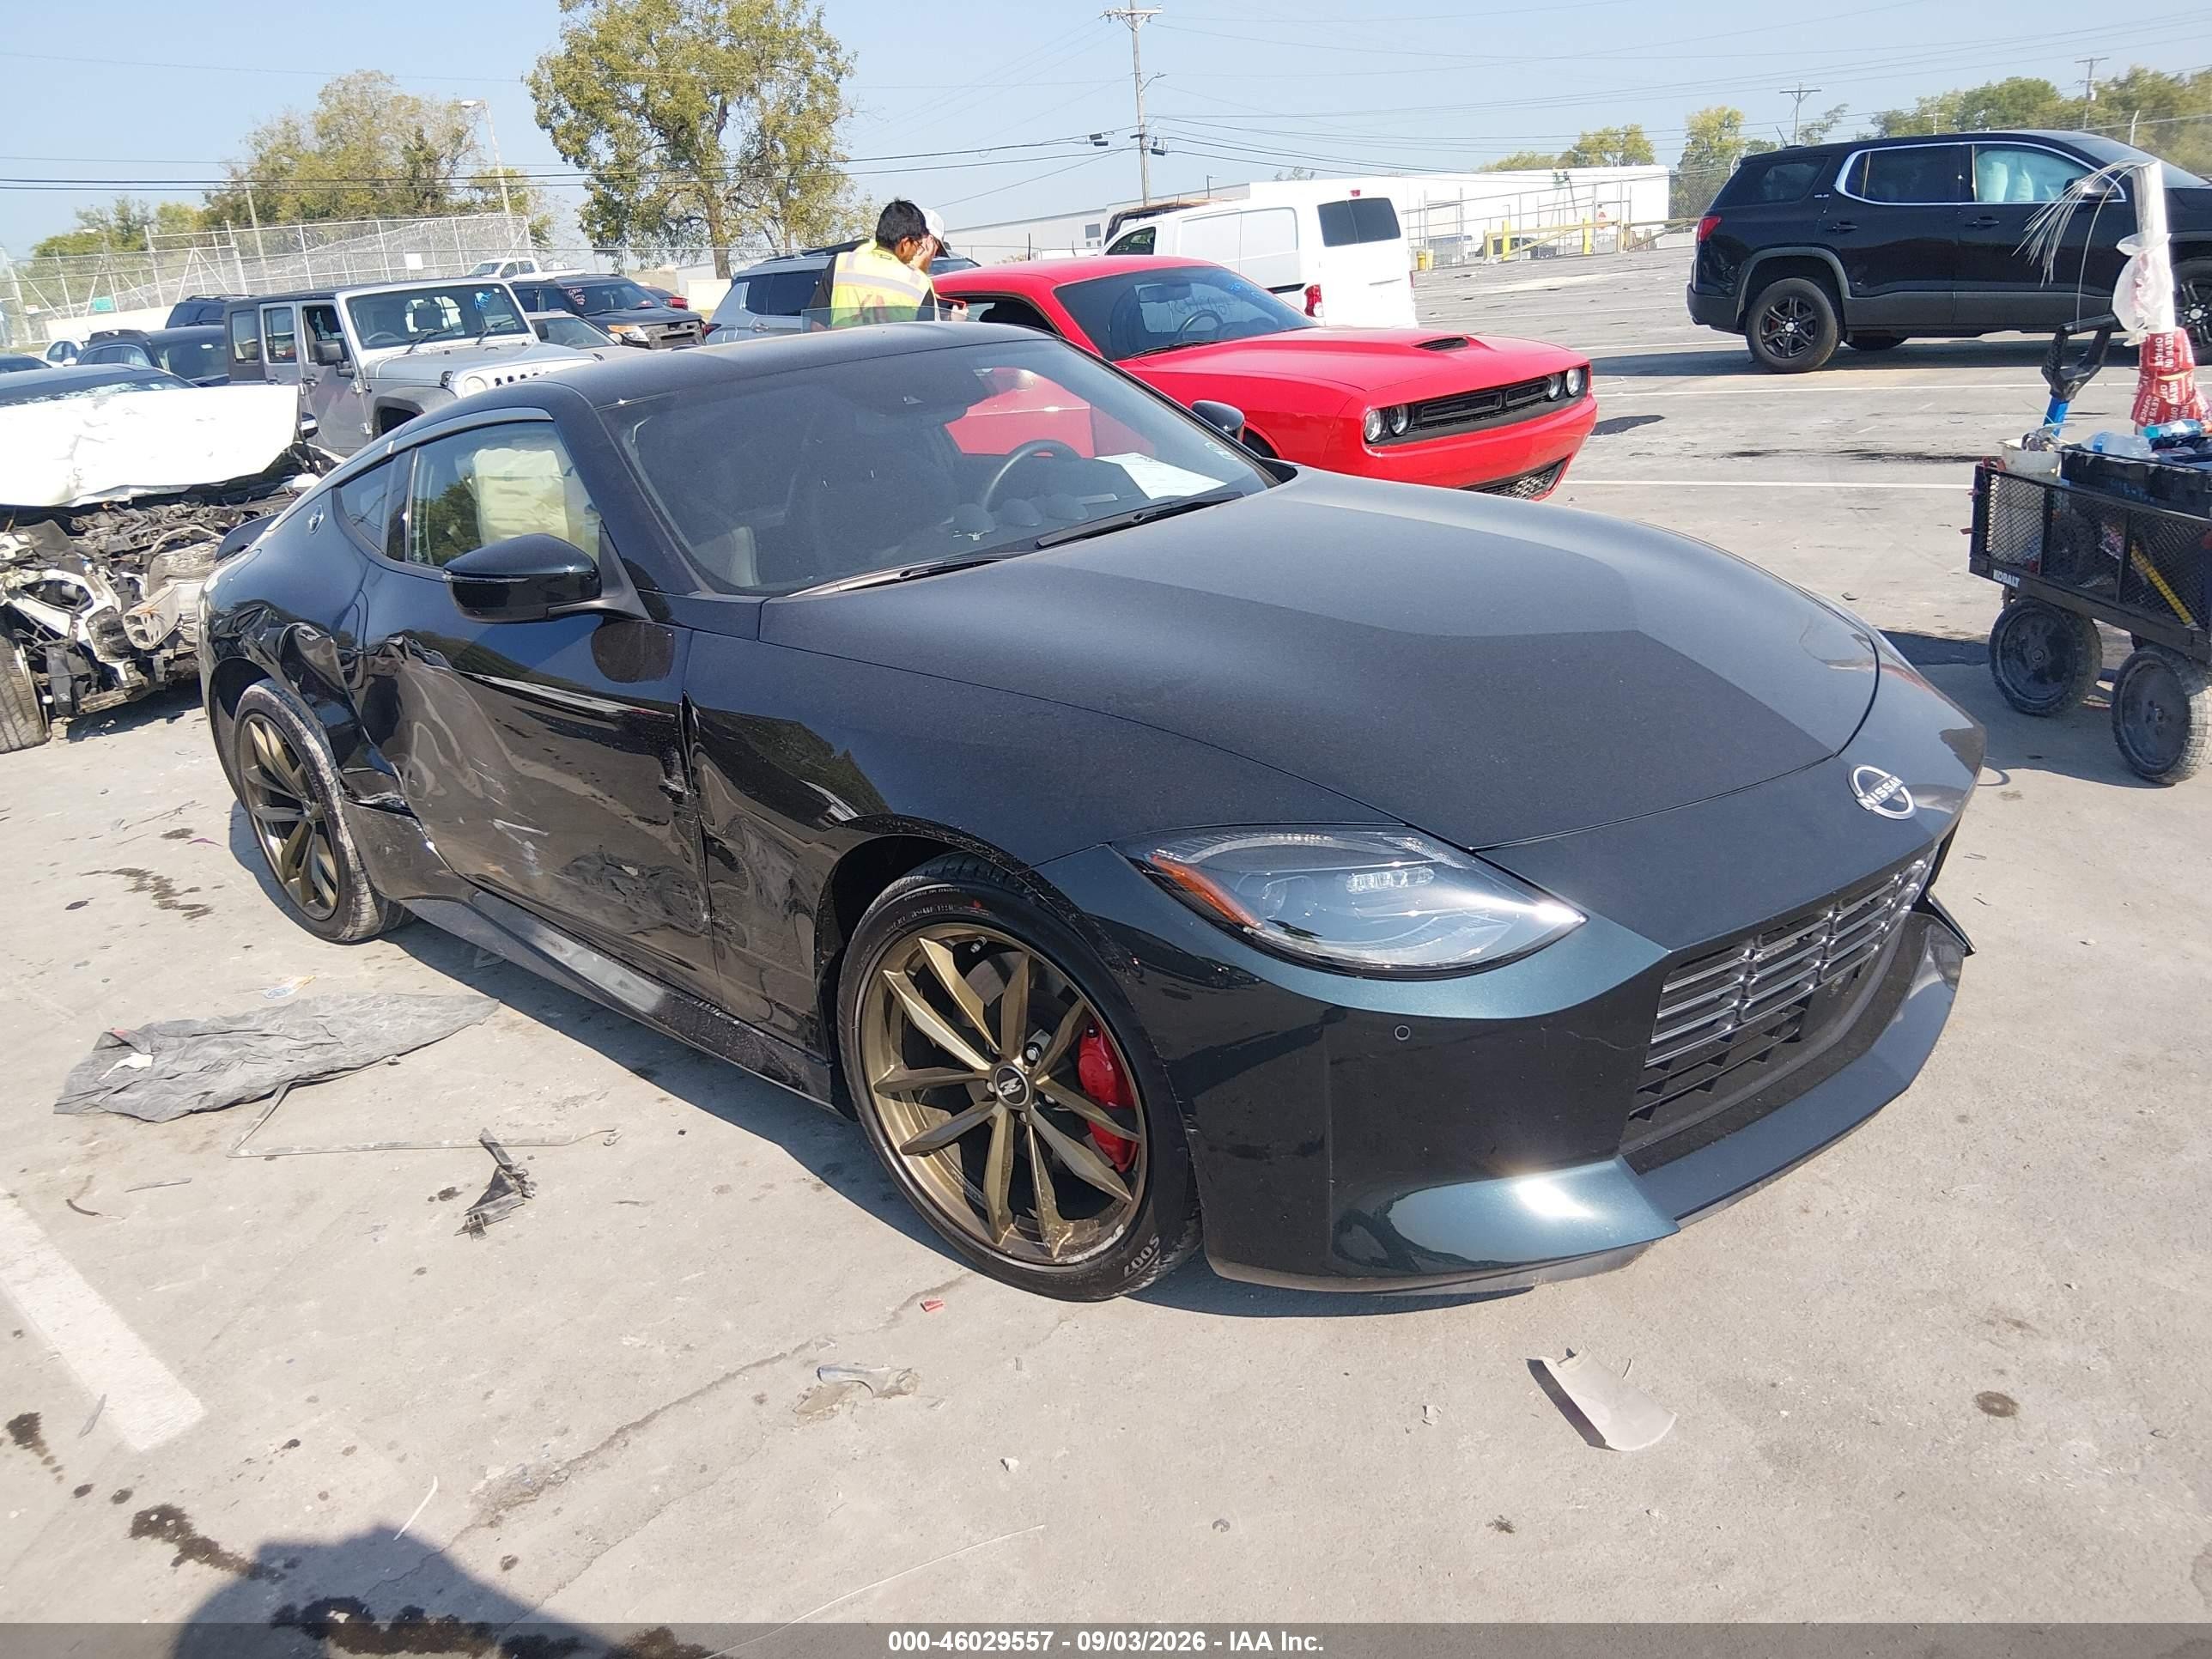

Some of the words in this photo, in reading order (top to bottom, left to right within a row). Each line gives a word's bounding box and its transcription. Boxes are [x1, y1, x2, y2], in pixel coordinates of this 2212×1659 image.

[2154, 337, 2164, 367] OFFICE
[2165, 332, 2175, 356] KEYS
[2165, 358, 2175, 368] IN
[1993, 568, 2020, 587] KOBALT
[1859, 775, 1904, 810] NISSAN
[1123, 1233, 1160, 1278] S007
